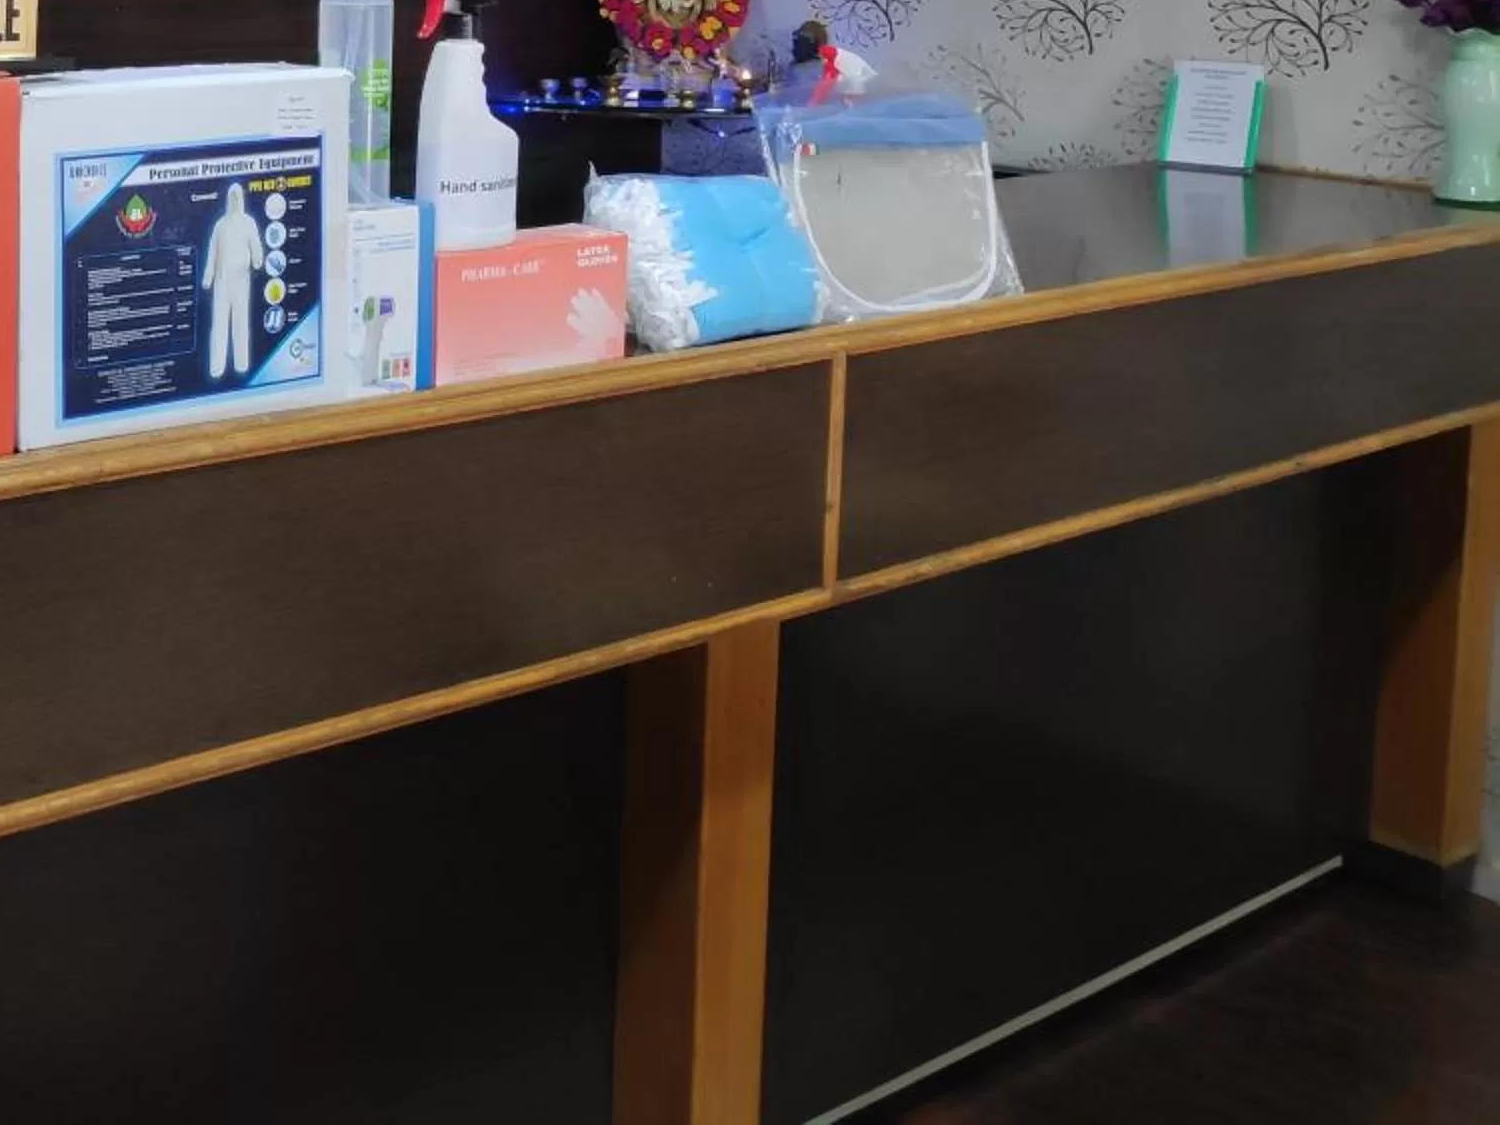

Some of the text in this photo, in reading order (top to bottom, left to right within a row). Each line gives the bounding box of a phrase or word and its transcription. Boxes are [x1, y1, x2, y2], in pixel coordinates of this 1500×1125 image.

[149, 152, 315, 181] Personal Protective Equipment
[440, 179, 476, 194] Hand
